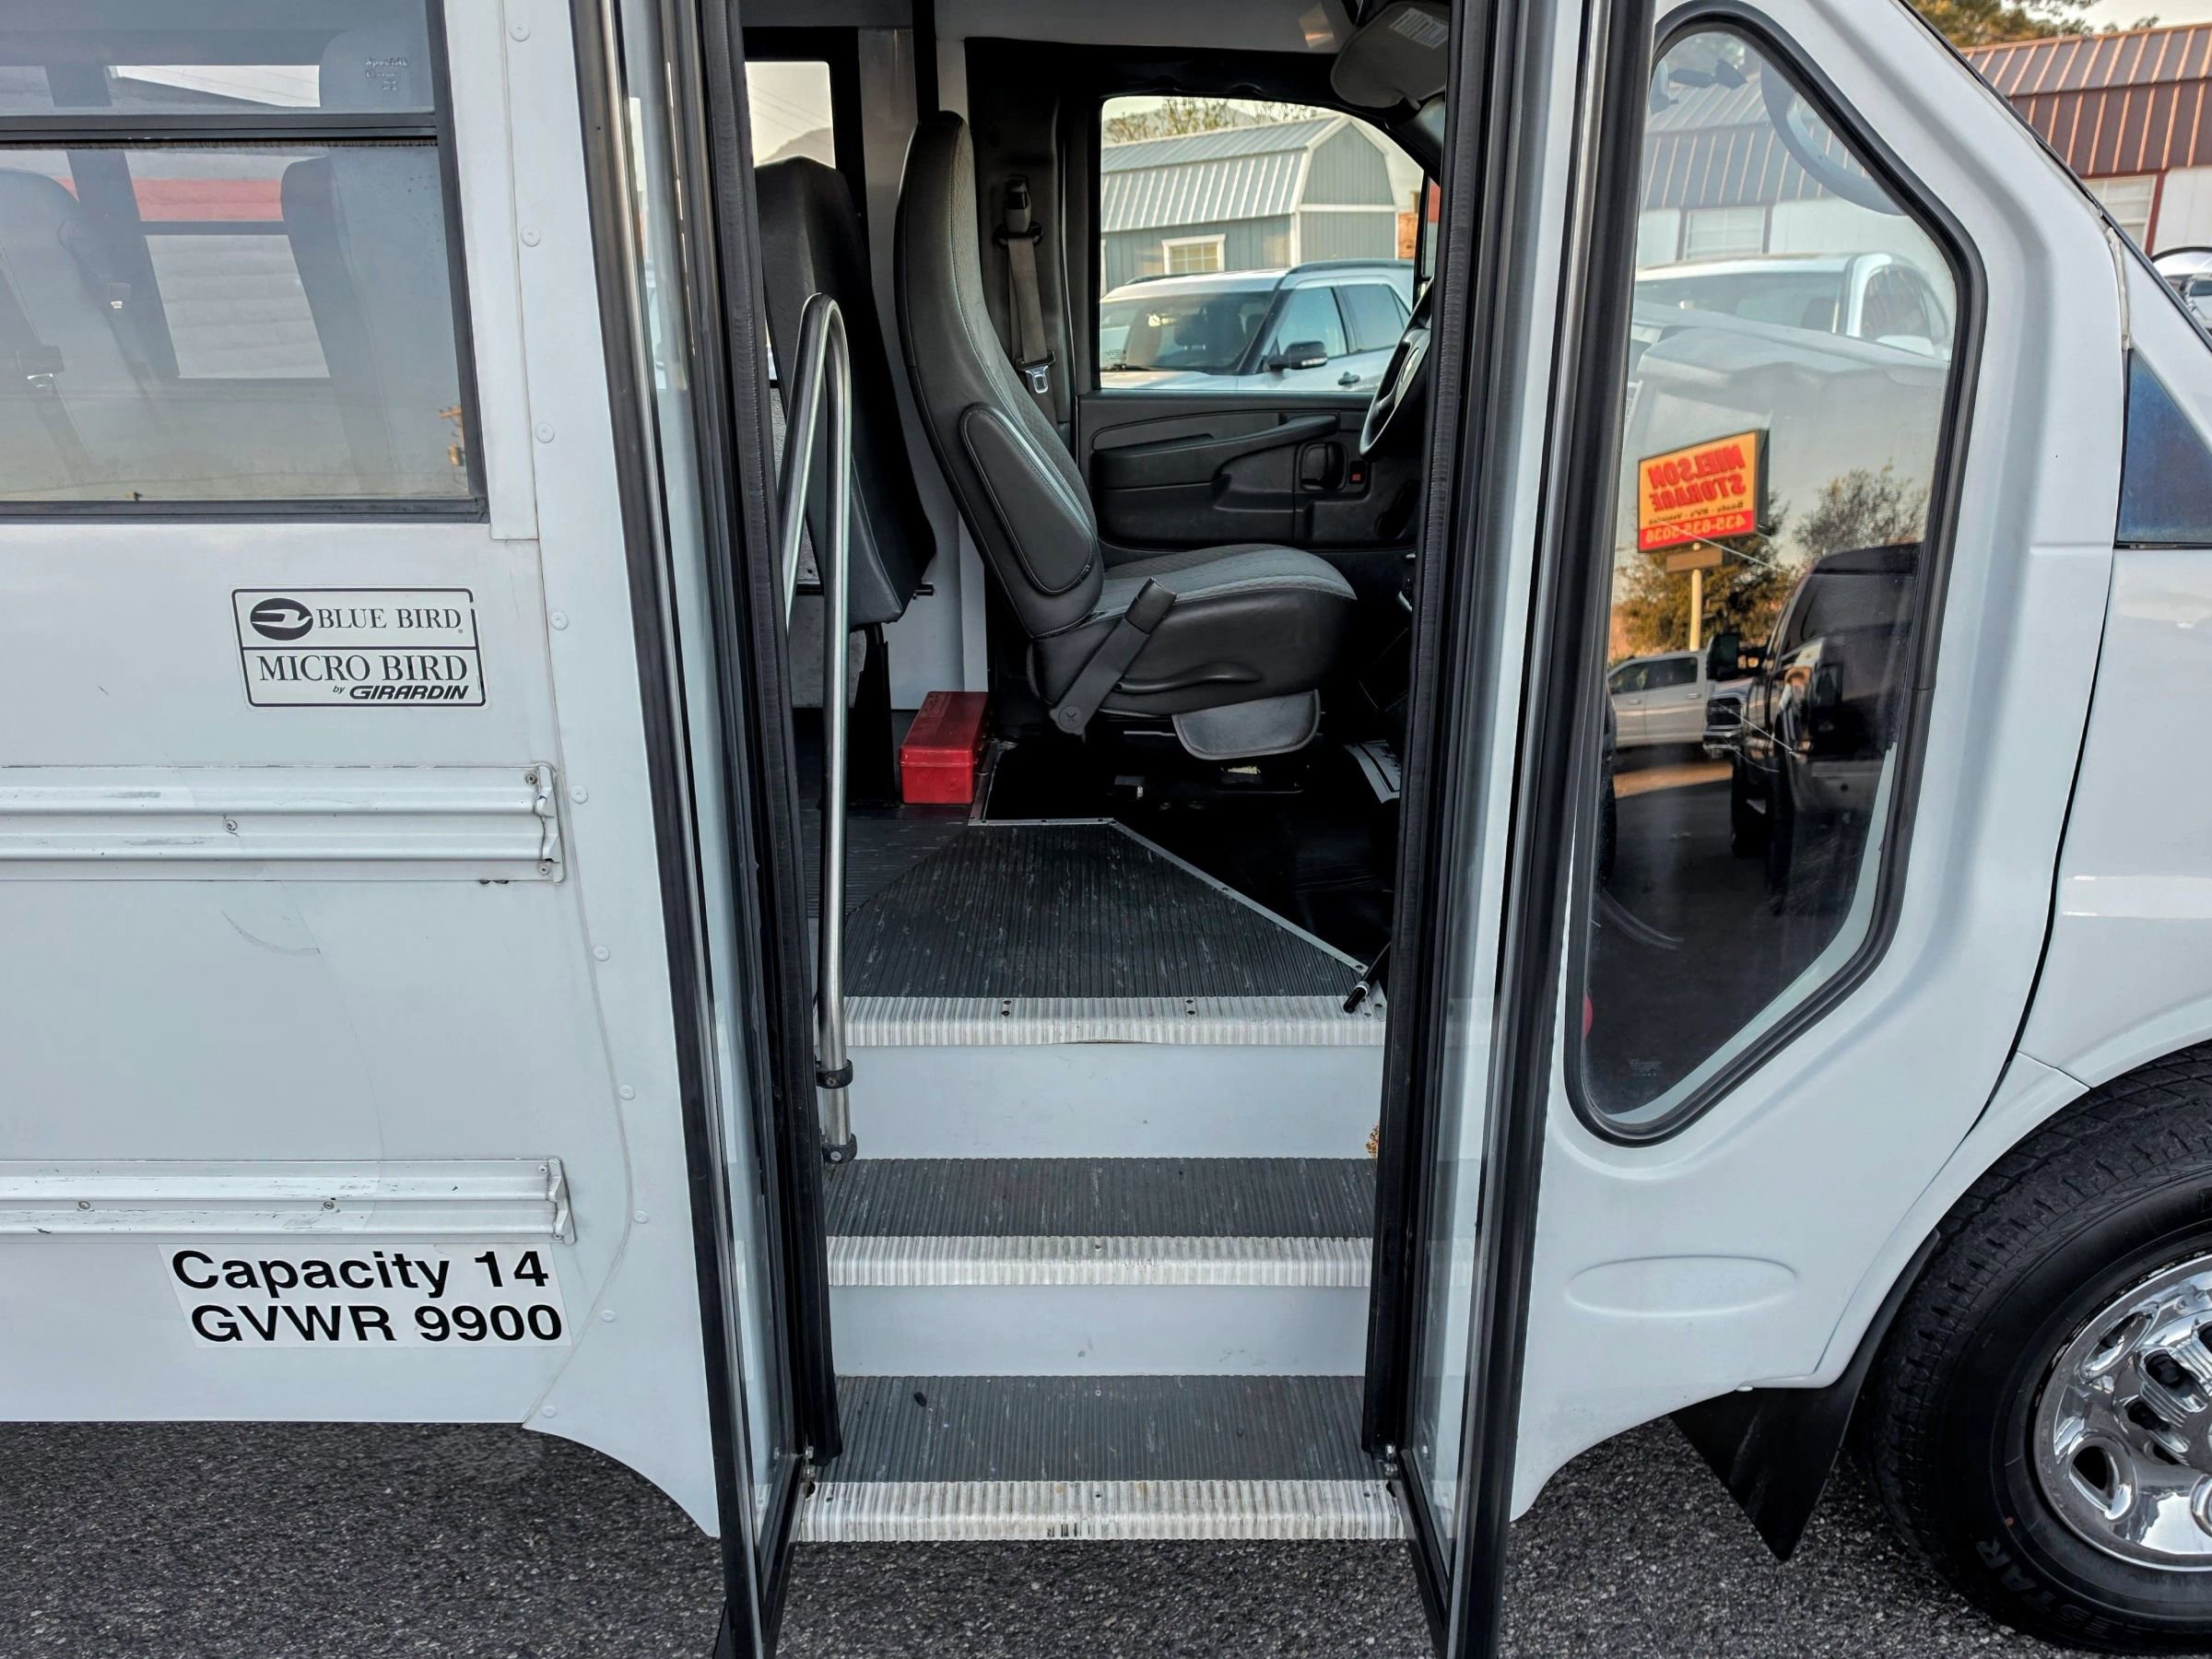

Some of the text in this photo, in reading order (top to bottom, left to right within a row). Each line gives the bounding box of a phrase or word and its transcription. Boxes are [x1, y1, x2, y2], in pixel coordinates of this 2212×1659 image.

[315, 608, 462, 629] BLUE BIRD
[256, 654, 468, 681] MICRO BIRD
[332, 685, 469, 700] by GIRARDIN
[171, 1250, 550, 1299] Capacity 14
[191, 1303, 563, 1342] GVWR 9900
